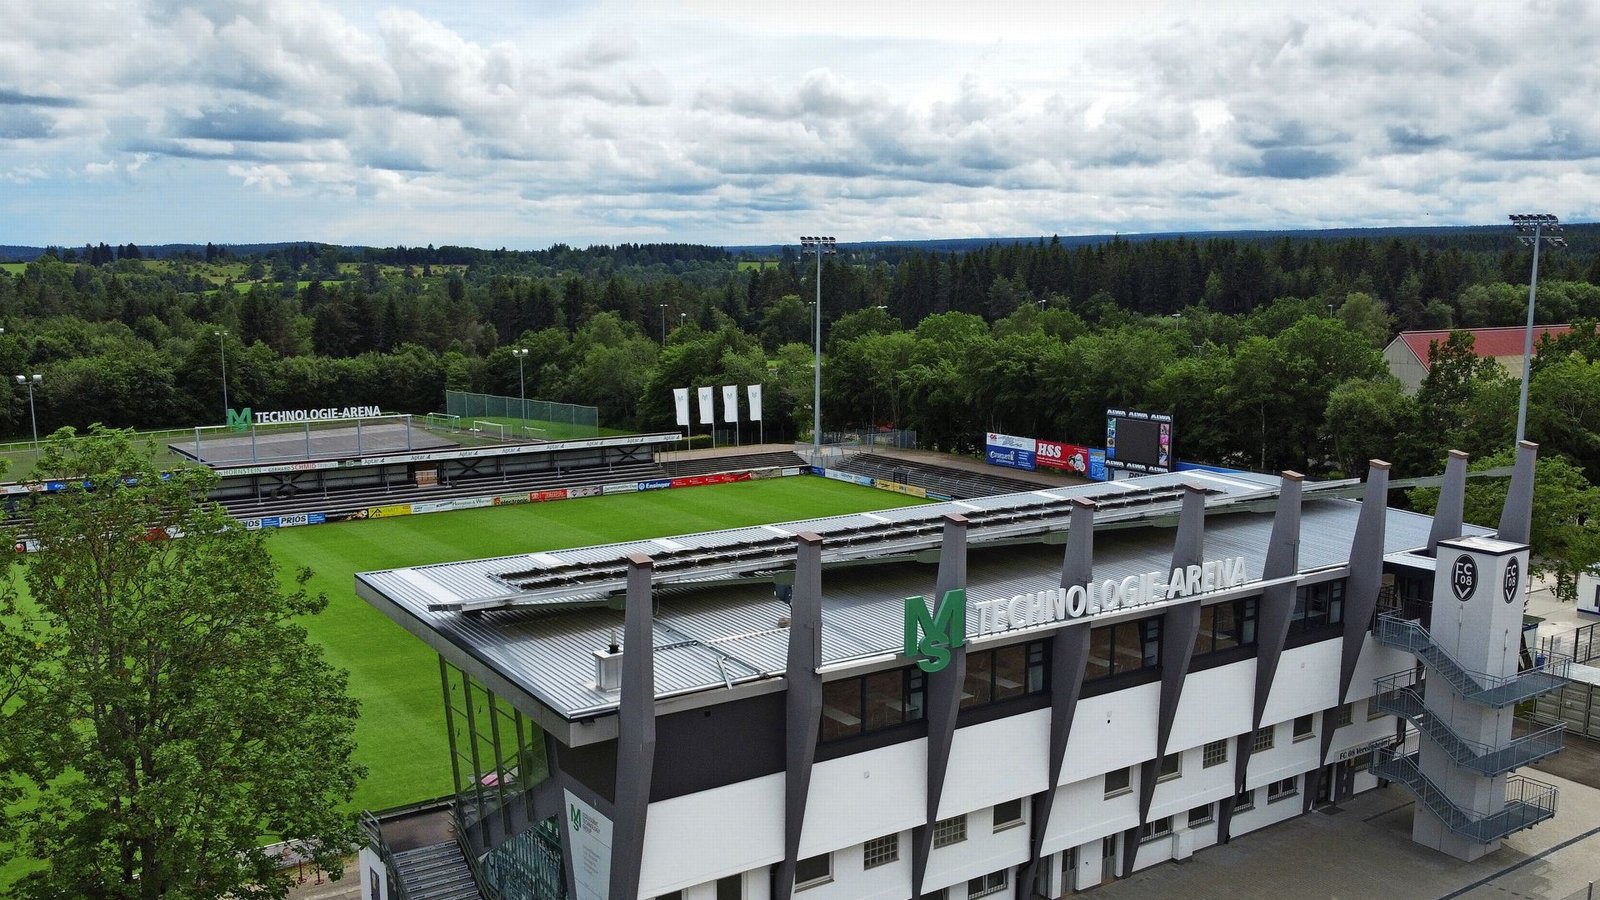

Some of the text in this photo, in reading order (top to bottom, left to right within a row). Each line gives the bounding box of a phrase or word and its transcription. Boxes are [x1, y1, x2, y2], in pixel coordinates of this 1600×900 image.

[255, 405, 382, 424] TECHNOLOGIE-ARENA
[1037, 443, 1062, 458] HSS
[223, 467, 262, 476] HORNSTEIN
[291, 462, 317, 471] SCHMID
[645, 481, 670, 489] Ensinger
[280, 515, 307, 526] PRIOS
[1455, 562, 1473, 583] FC
[1505, 564, 1517, 588] FC
[1460, 575, 1473, 586] 08
[1508, 577, 1516, 588] 08
[973, 556, 1250, 635] TECHNOLOGIE-ARENA
[1339, 752, 1347, 760] FC
